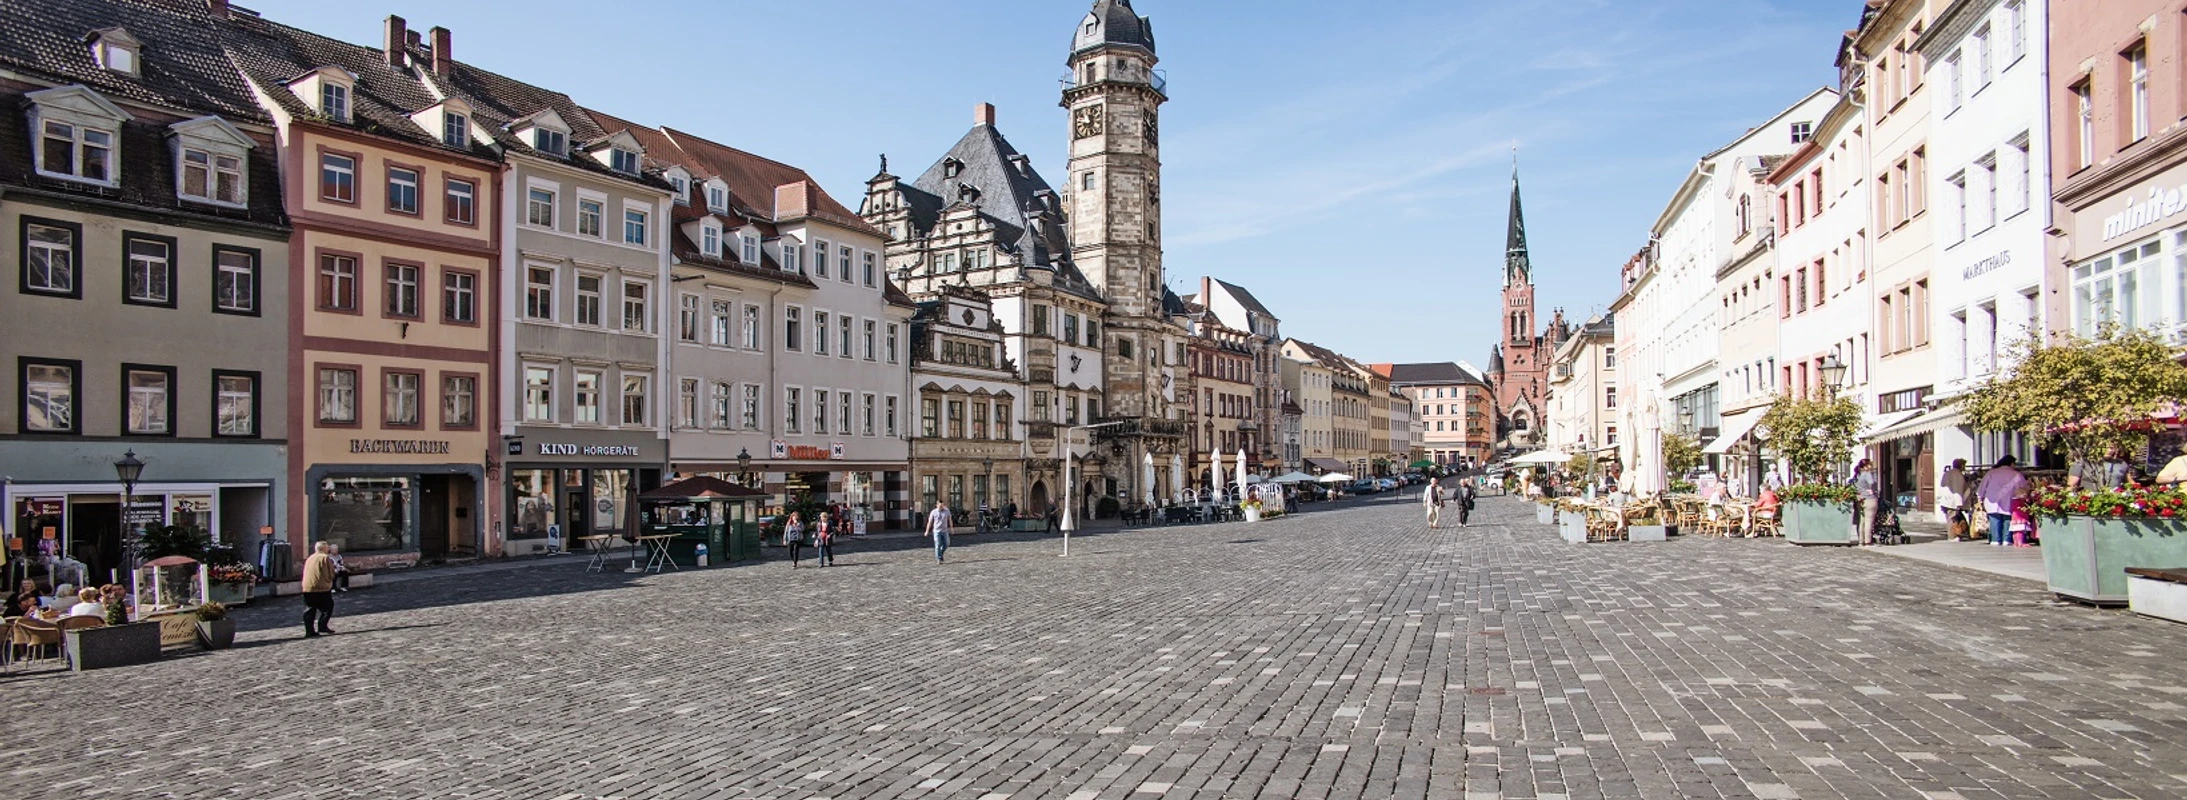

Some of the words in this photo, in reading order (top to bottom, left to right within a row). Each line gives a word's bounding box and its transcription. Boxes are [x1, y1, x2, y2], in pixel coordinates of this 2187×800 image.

[1963, 250, 2011, 281] MARKTHAUS
[350, 439, 449, 453] BACKWAREN
[540, 443, 577, 455] KIND
